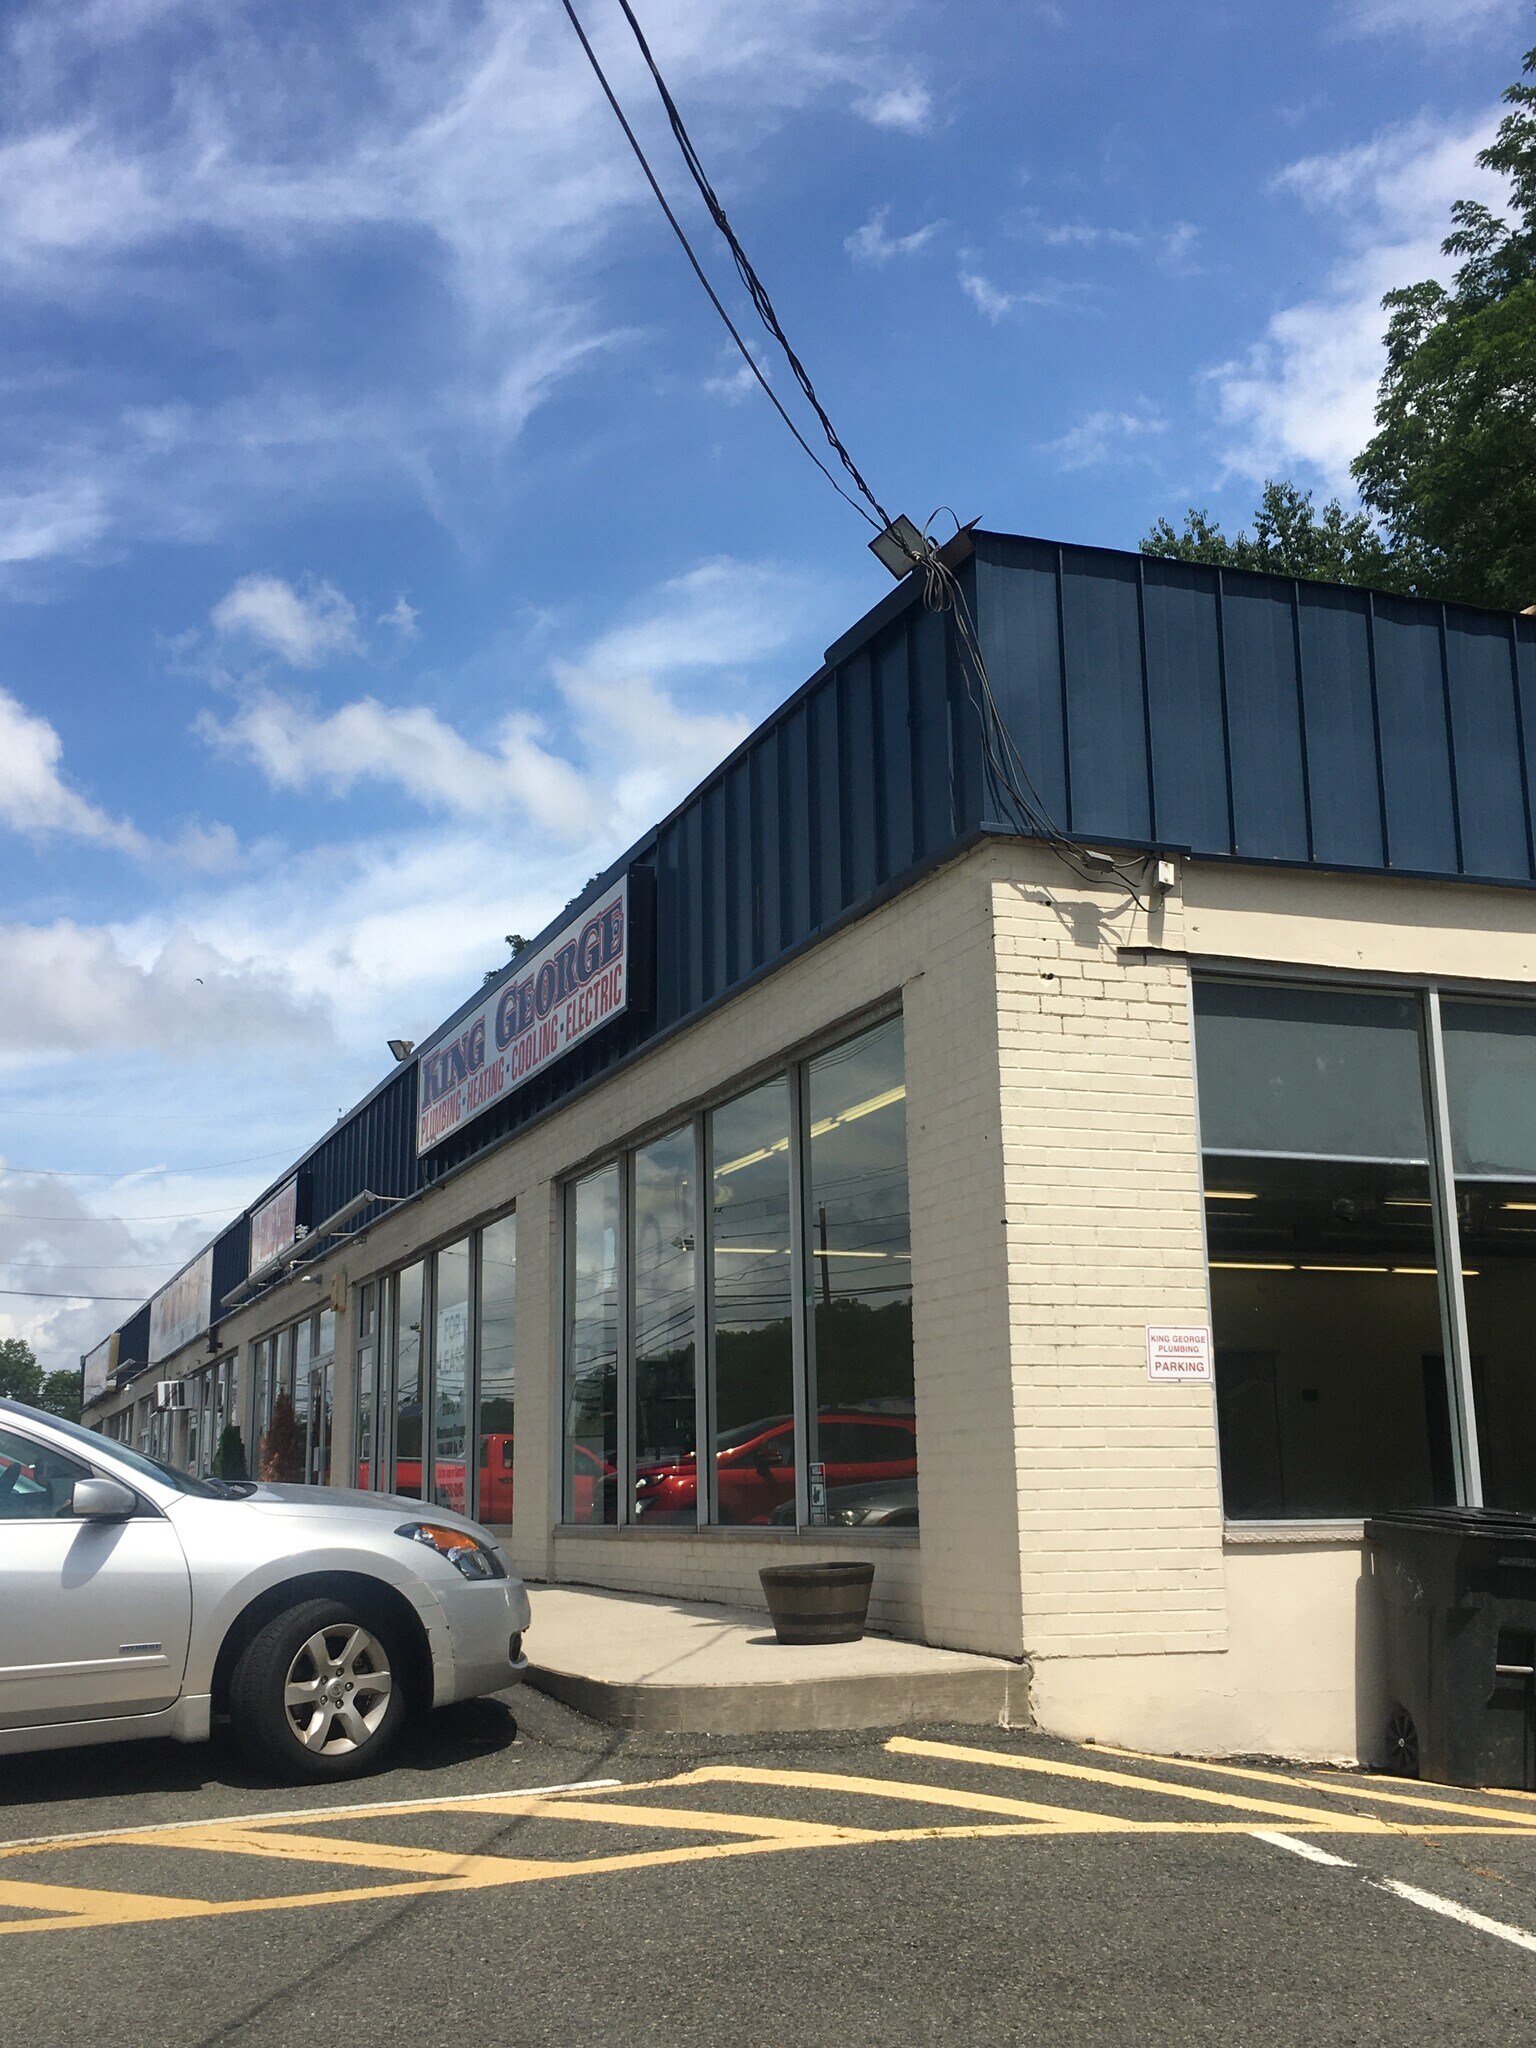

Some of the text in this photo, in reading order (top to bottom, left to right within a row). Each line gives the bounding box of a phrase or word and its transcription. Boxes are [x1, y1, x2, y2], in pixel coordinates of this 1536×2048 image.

[421, 895, 624, 1112] KING GEORGE
[420, 963, 622, 1146] PLUMBING HEATING COOLING ELECTRIC
[1172, 1335, 1206, 1343] GEORGE
[1158, 1345, 1199, 1353] PLUMBING
[1155, 1361, 1204, 1372] PARKING
